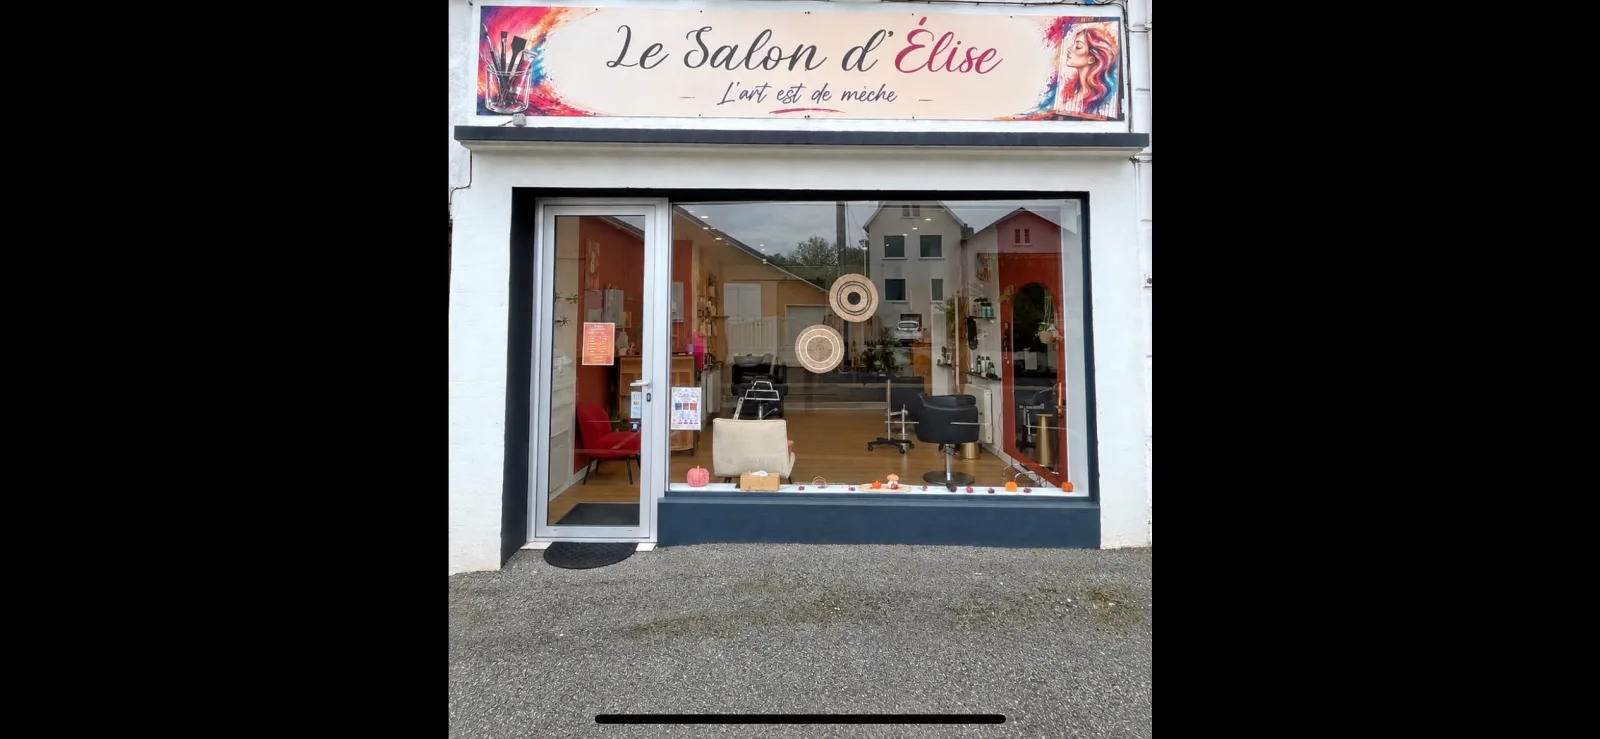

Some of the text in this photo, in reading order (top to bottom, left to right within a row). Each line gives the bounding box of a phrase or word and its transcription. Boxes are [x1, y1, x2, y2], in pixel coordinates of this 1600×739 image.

[606, 25, 670, 69] Le
[683, 26, 828, 72] Salon
[716, 82, 898, 106] L'art est de mèche
